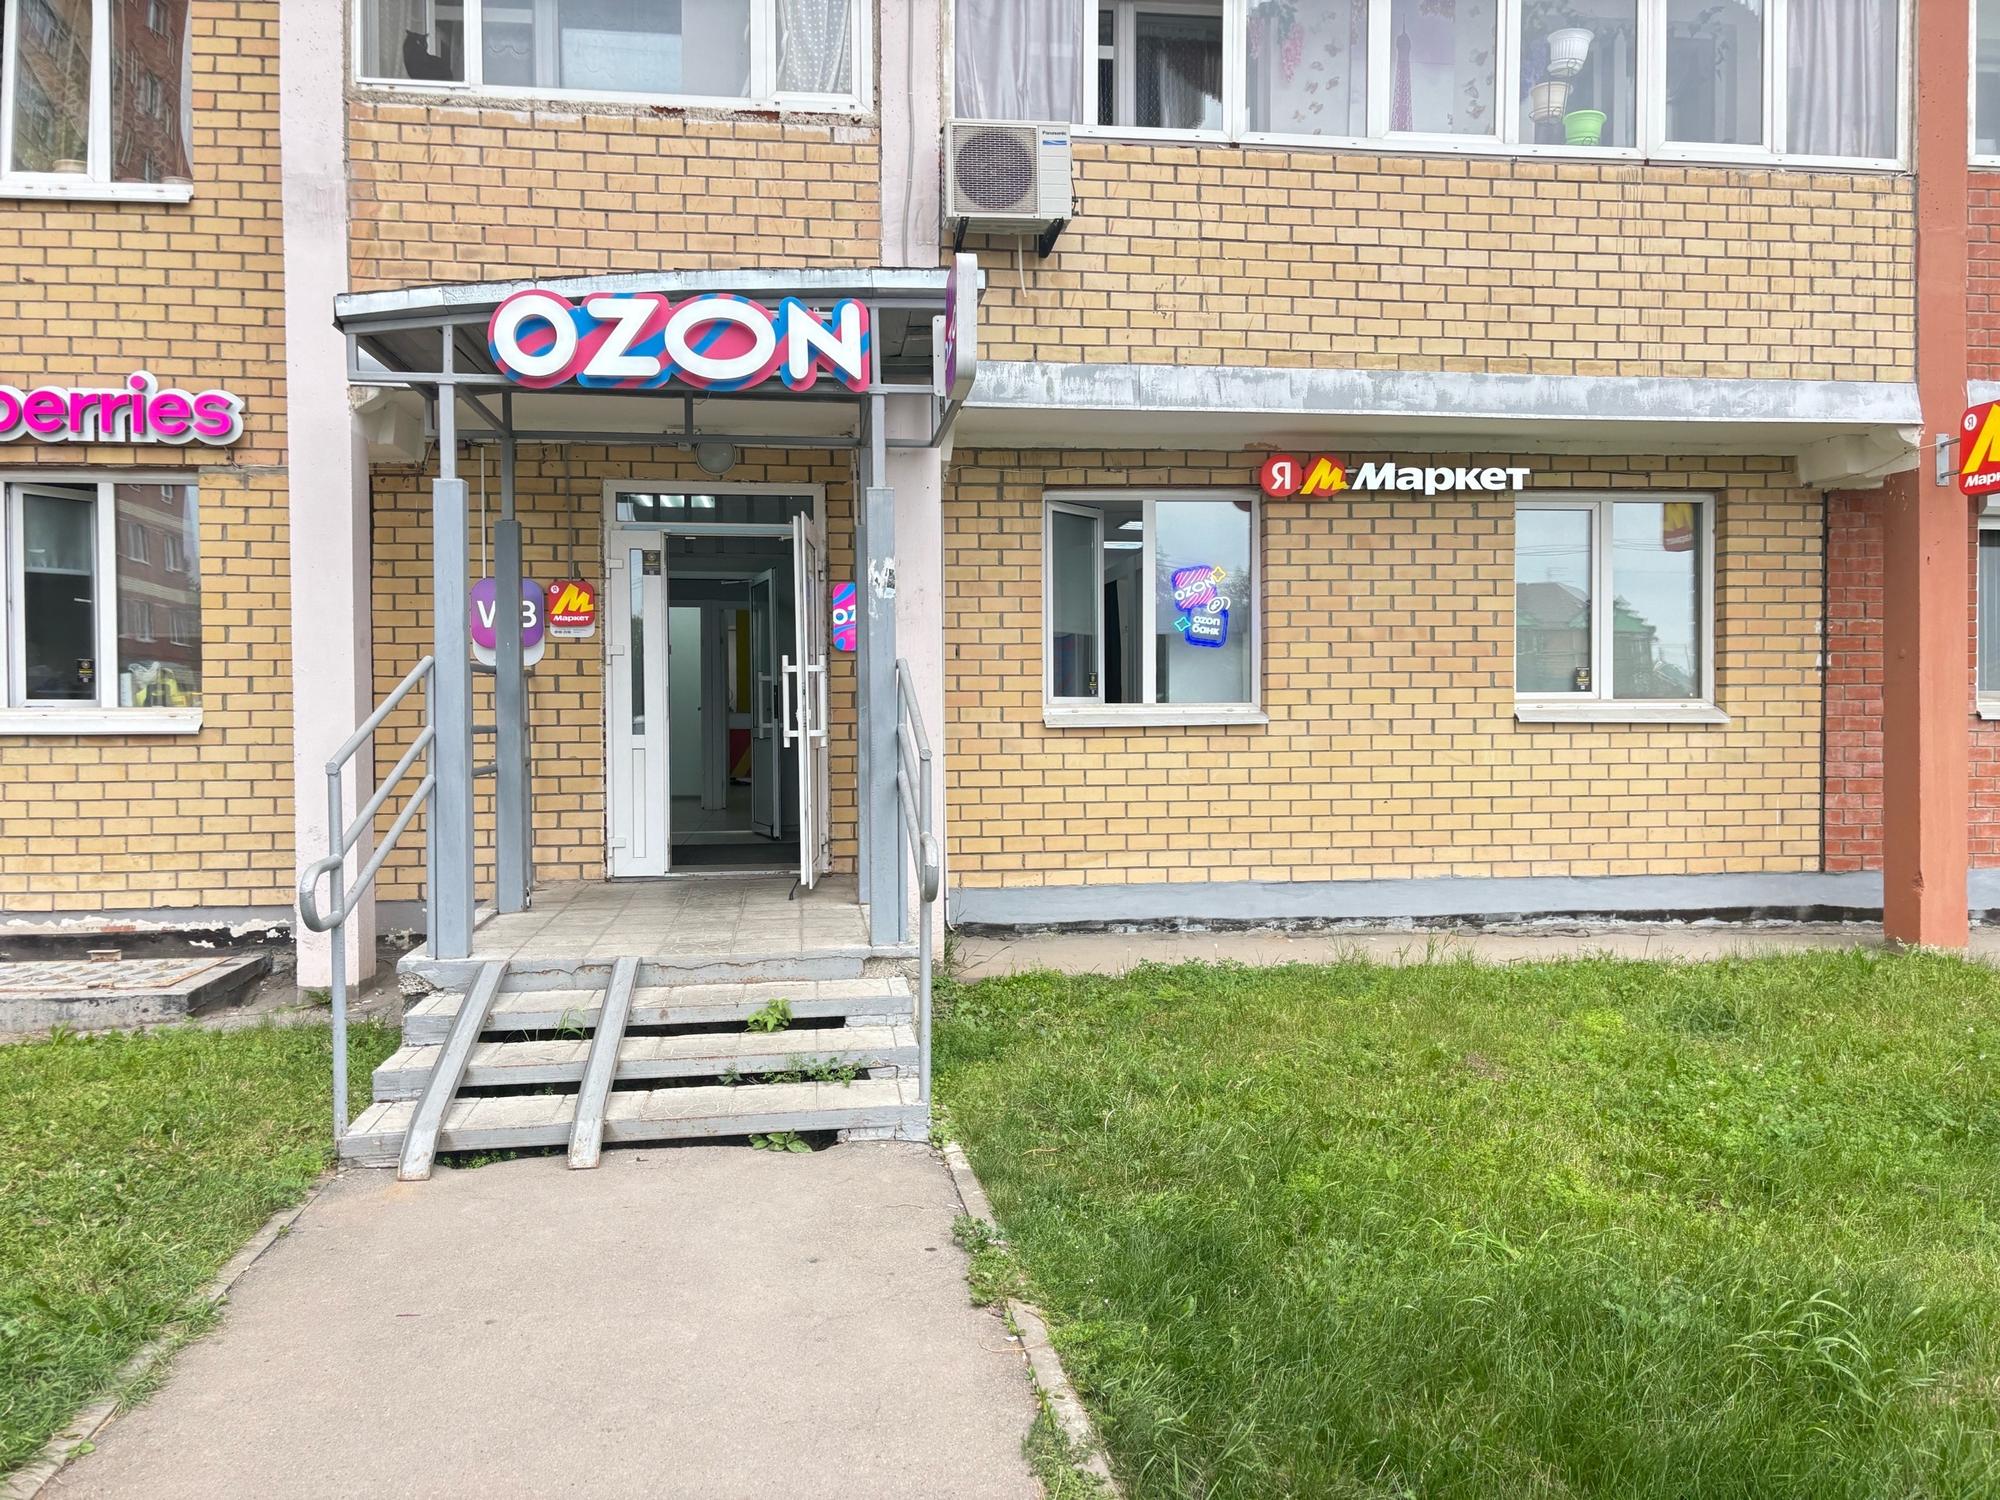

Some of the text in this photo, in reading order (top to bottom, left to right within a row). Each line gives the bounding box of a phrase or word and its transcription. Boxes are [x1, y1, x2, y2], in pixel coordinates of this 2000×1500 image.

[492, 294, 863, 382] OZON
[1271, 461, 1291, 490] Я
[1351, 461, 1531, 496] Маркет
[1964, 471, 2000, 488] Мар
[1174, 574, 1217, 601] OZON
[1192, 624, 1219, 635] банк
